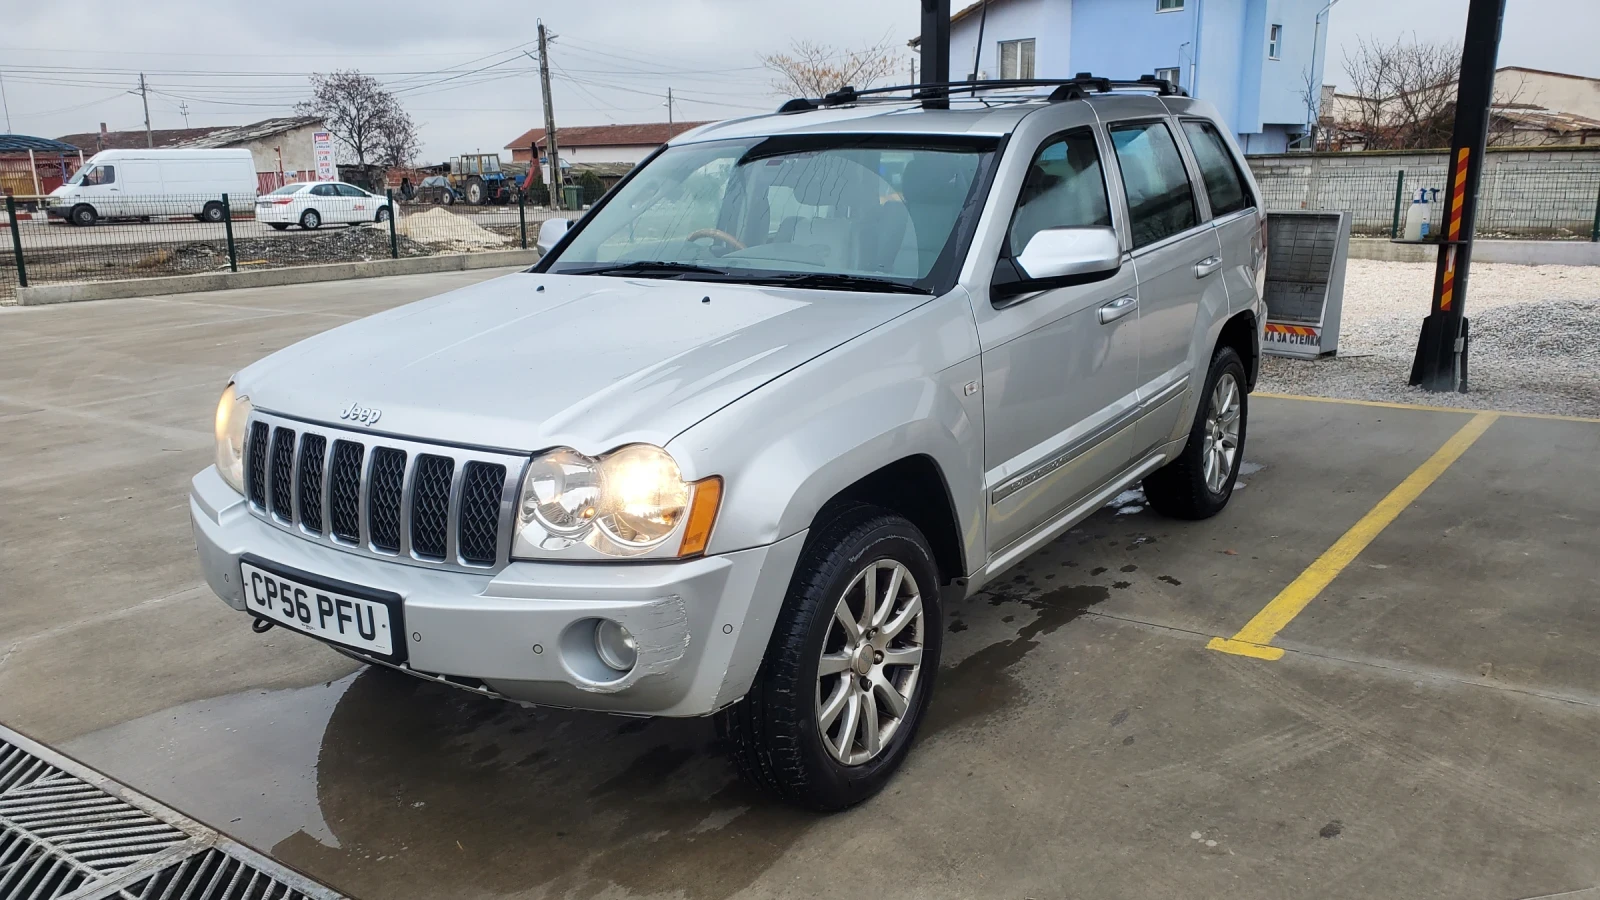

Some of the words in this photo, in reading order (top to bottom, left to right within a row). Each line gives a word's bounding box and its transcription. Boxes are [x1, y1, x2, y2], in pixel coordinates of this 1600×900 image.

[1262, 331, 1274, 342] КА
[1277, 332, 1287, 344] ЗА
[340, 402, 382, 427] Jeep
[251, 571, 312, 624] CP56
[316, 593, 376, 641] PFU
